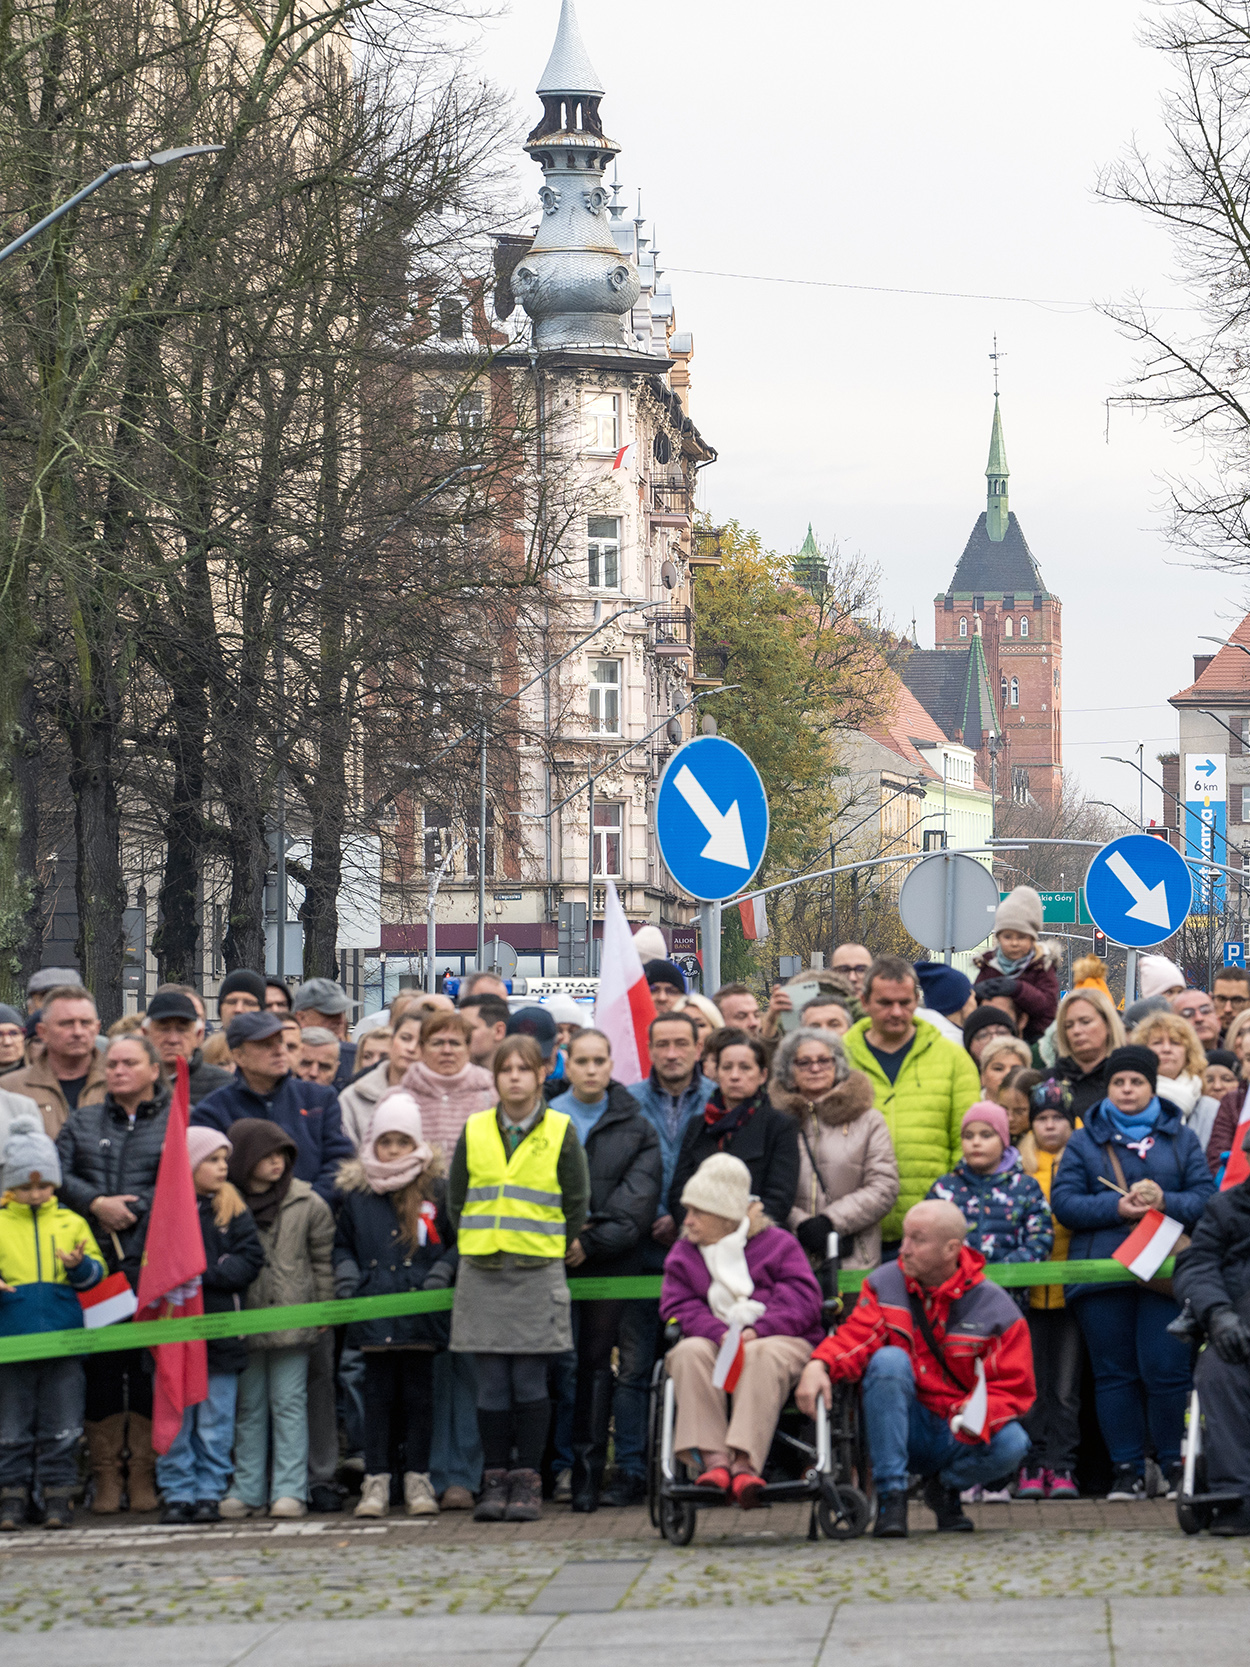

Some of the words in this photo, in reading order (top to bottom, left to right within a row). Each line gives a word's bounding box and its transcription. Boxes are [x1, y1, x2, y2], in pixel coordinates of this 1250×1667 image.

[1194, 780, 1202, 791] 6
[1203, 783, 1218, 791] km
[1054, 894, 1073, 902] Góry
[1228, 944, 1240, 960] P
